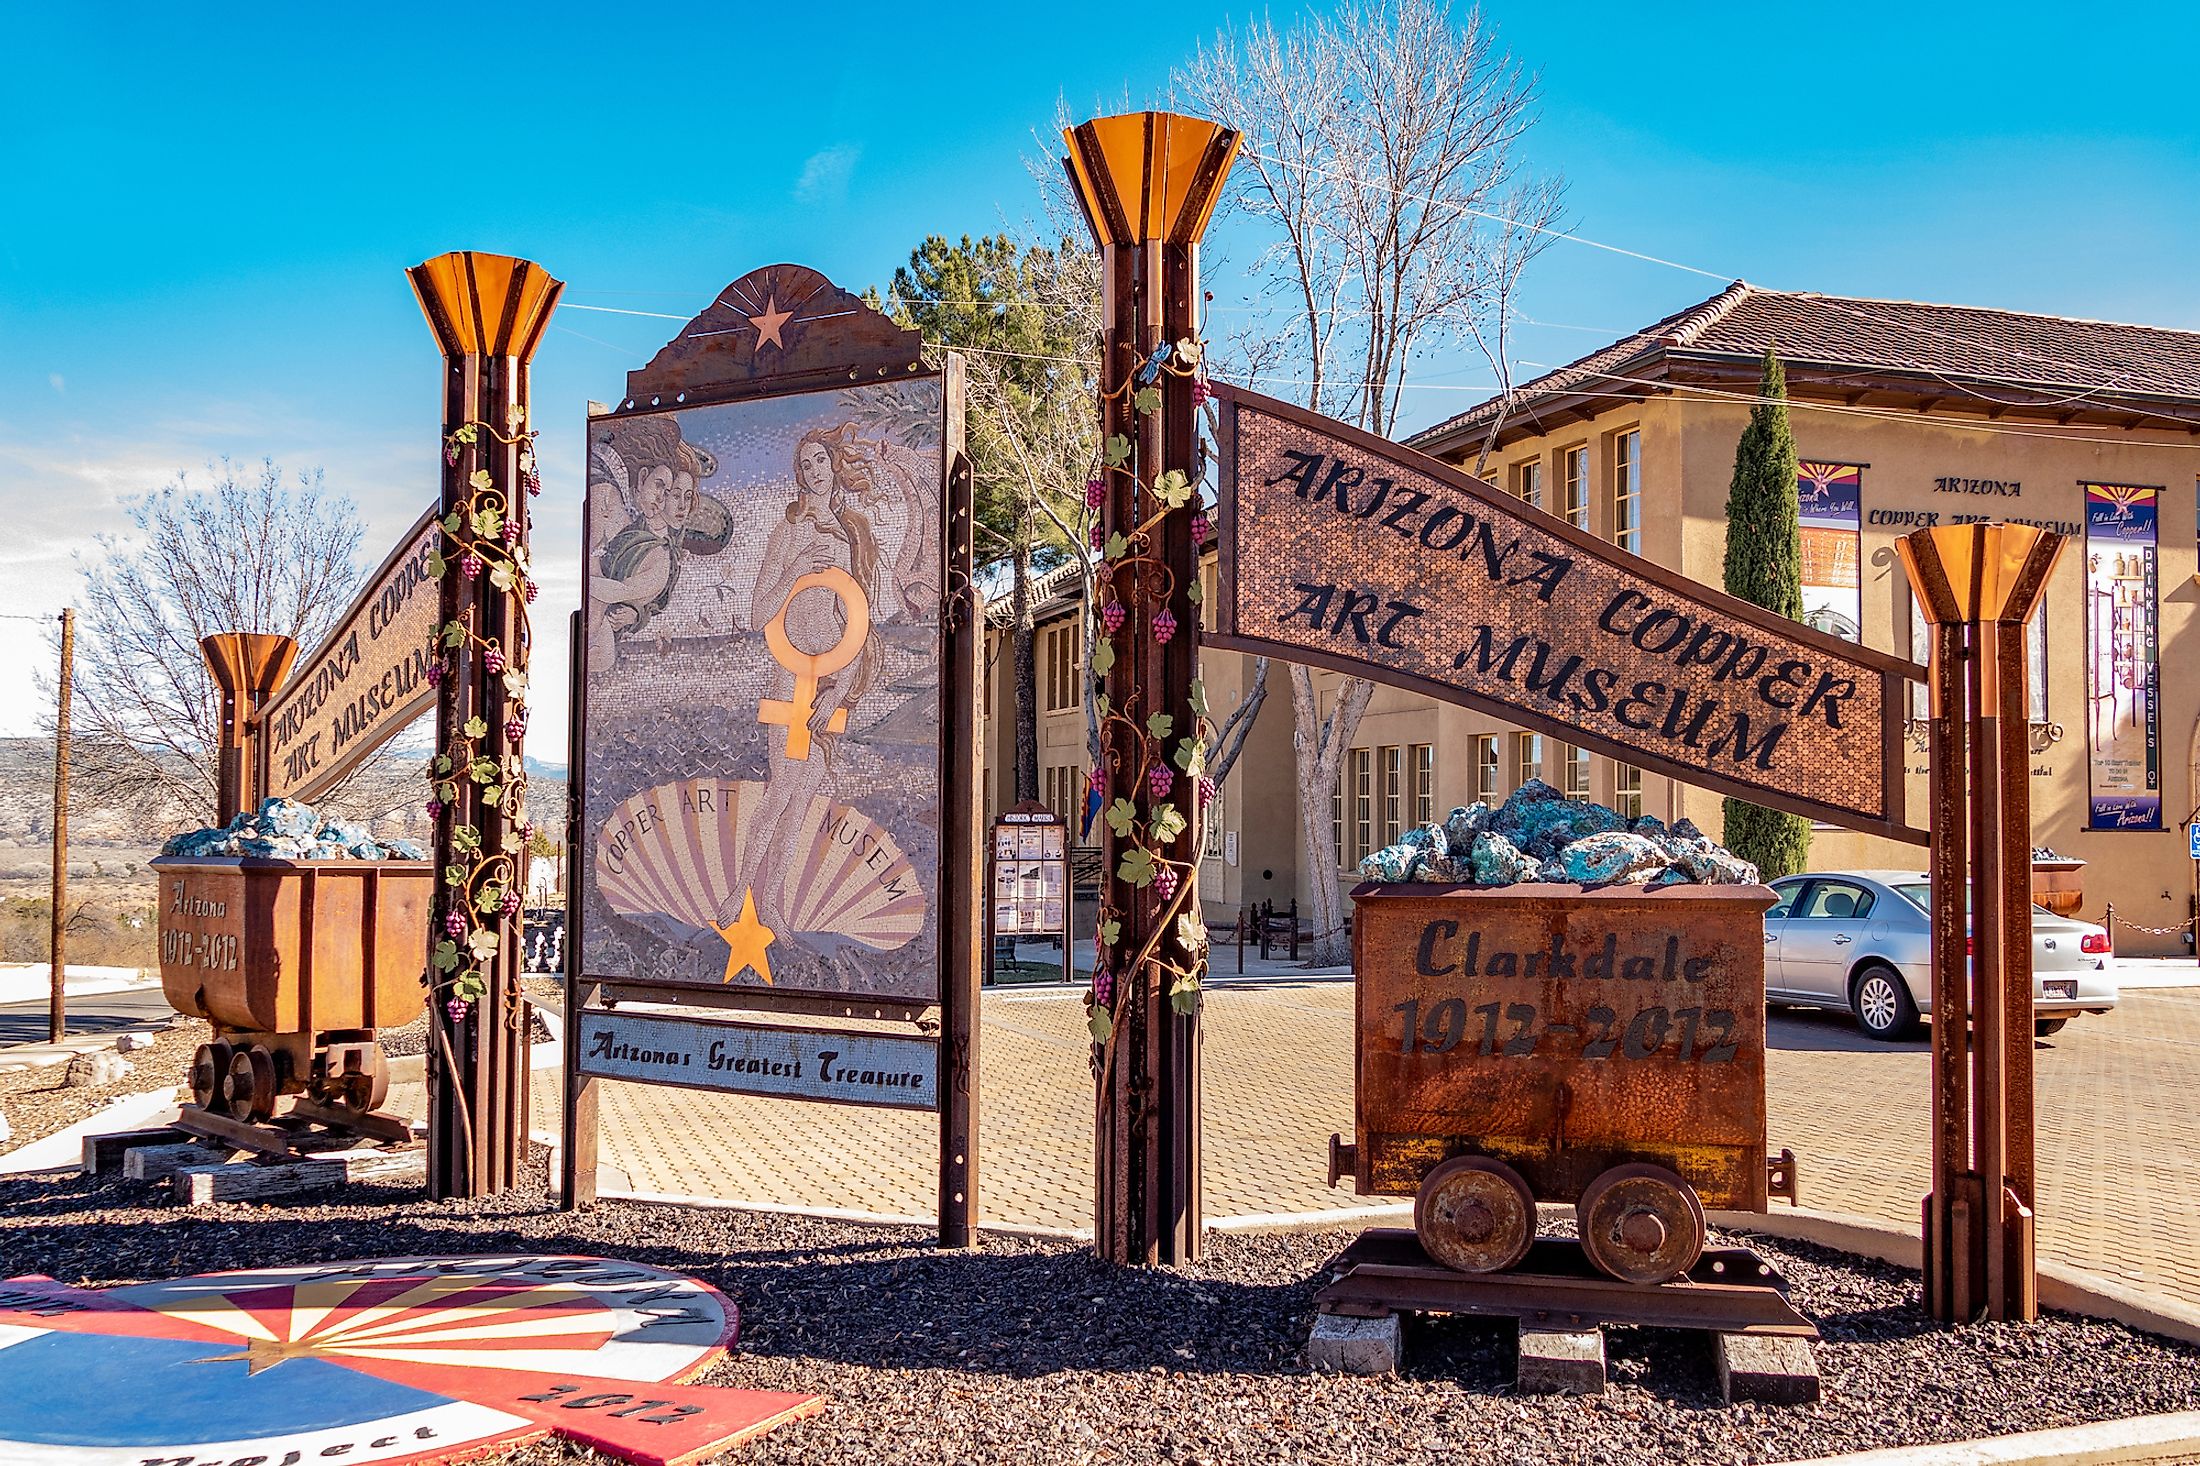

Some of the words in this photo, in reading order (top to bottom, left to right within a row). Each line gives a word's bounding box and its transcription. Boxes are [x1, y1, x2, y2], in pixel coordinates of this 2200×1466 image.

[1868, 509, 1940, 527] COPPER
[1933, 477, 2021, 498] ARIZONA
[2116, 519, 2153, 537] Copper!!
[1265, 449, 1574, 603] ARIZONA
[1600, 589, 1855, 731] COPPER
[2145, 549, 2154, 648] DRINKING
[273, 630, 361, 755] ARIZONA
[1278, 582, 1425, 650] ART
[1453, 624, 1789, 770] MUSEUM
[2146, 662, 2155, 749] VESSELS
[283, 730, 321, 790] ART
[331, 638, 434, 756] MUSEUM
[605, 803, 665, 875] COPPER
[682, 788, 737, 812] ART
[2117, 807, 2155, 826] Arizona!!
[819, 809, 907, 902] MUSEUM
[170, 879, 226, 918] Arizona
[162, 928, 238, 972] 1912-2012
[1416, 919, 1713, 983] Clarkdale
[589, 1030, 691, 1066] Arizonas
[707, 1040, 803, 1079] Greatest
[817, 1050, 924, 1089] Treasure
[1393, 997, 1740, 1064] 1912-2012
